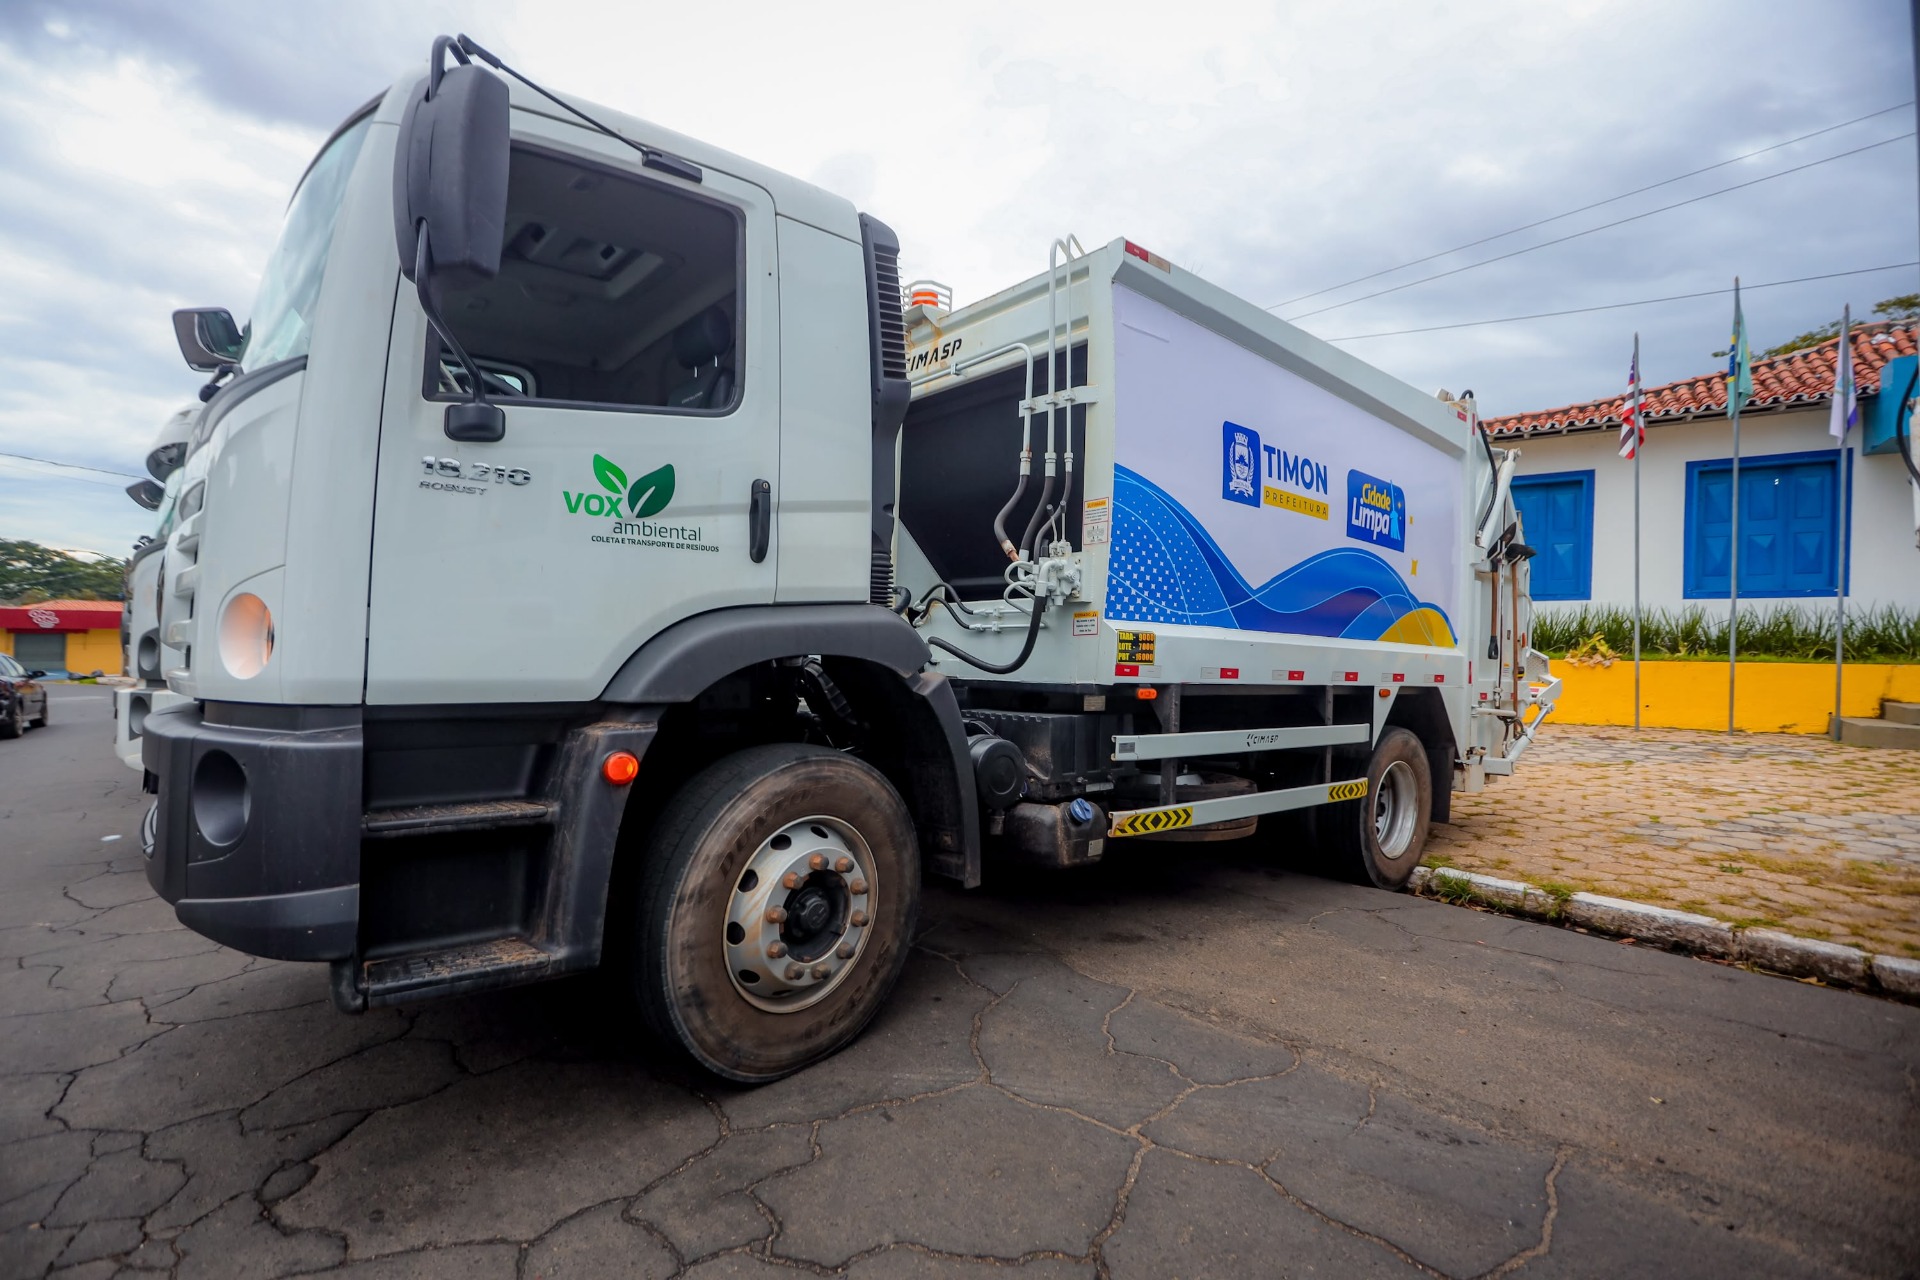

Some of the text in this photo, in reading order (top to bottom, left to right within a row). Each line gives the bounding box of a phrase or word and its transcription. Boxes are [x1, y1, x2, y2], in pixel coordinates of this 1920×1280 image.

[907, 338, 963, 372] IMASP
[1263, 444, 1328, 495] TIMON
[418, 480, 488, 496] ROBUST
[1362, 483, 1391, 511] Cidade
[563, 490, 624, 519] VOX
[1265, 490, 1328, 516] PREFEITURA
[613, 521, 701, 542] ambiental
[1351, 496, 1390, 540] Limpa
[591, 535, 720, 553] COLETA E TRANSPORTE DE RESÍDUOS
[1253, 734, 1279, 744] CIMASP
